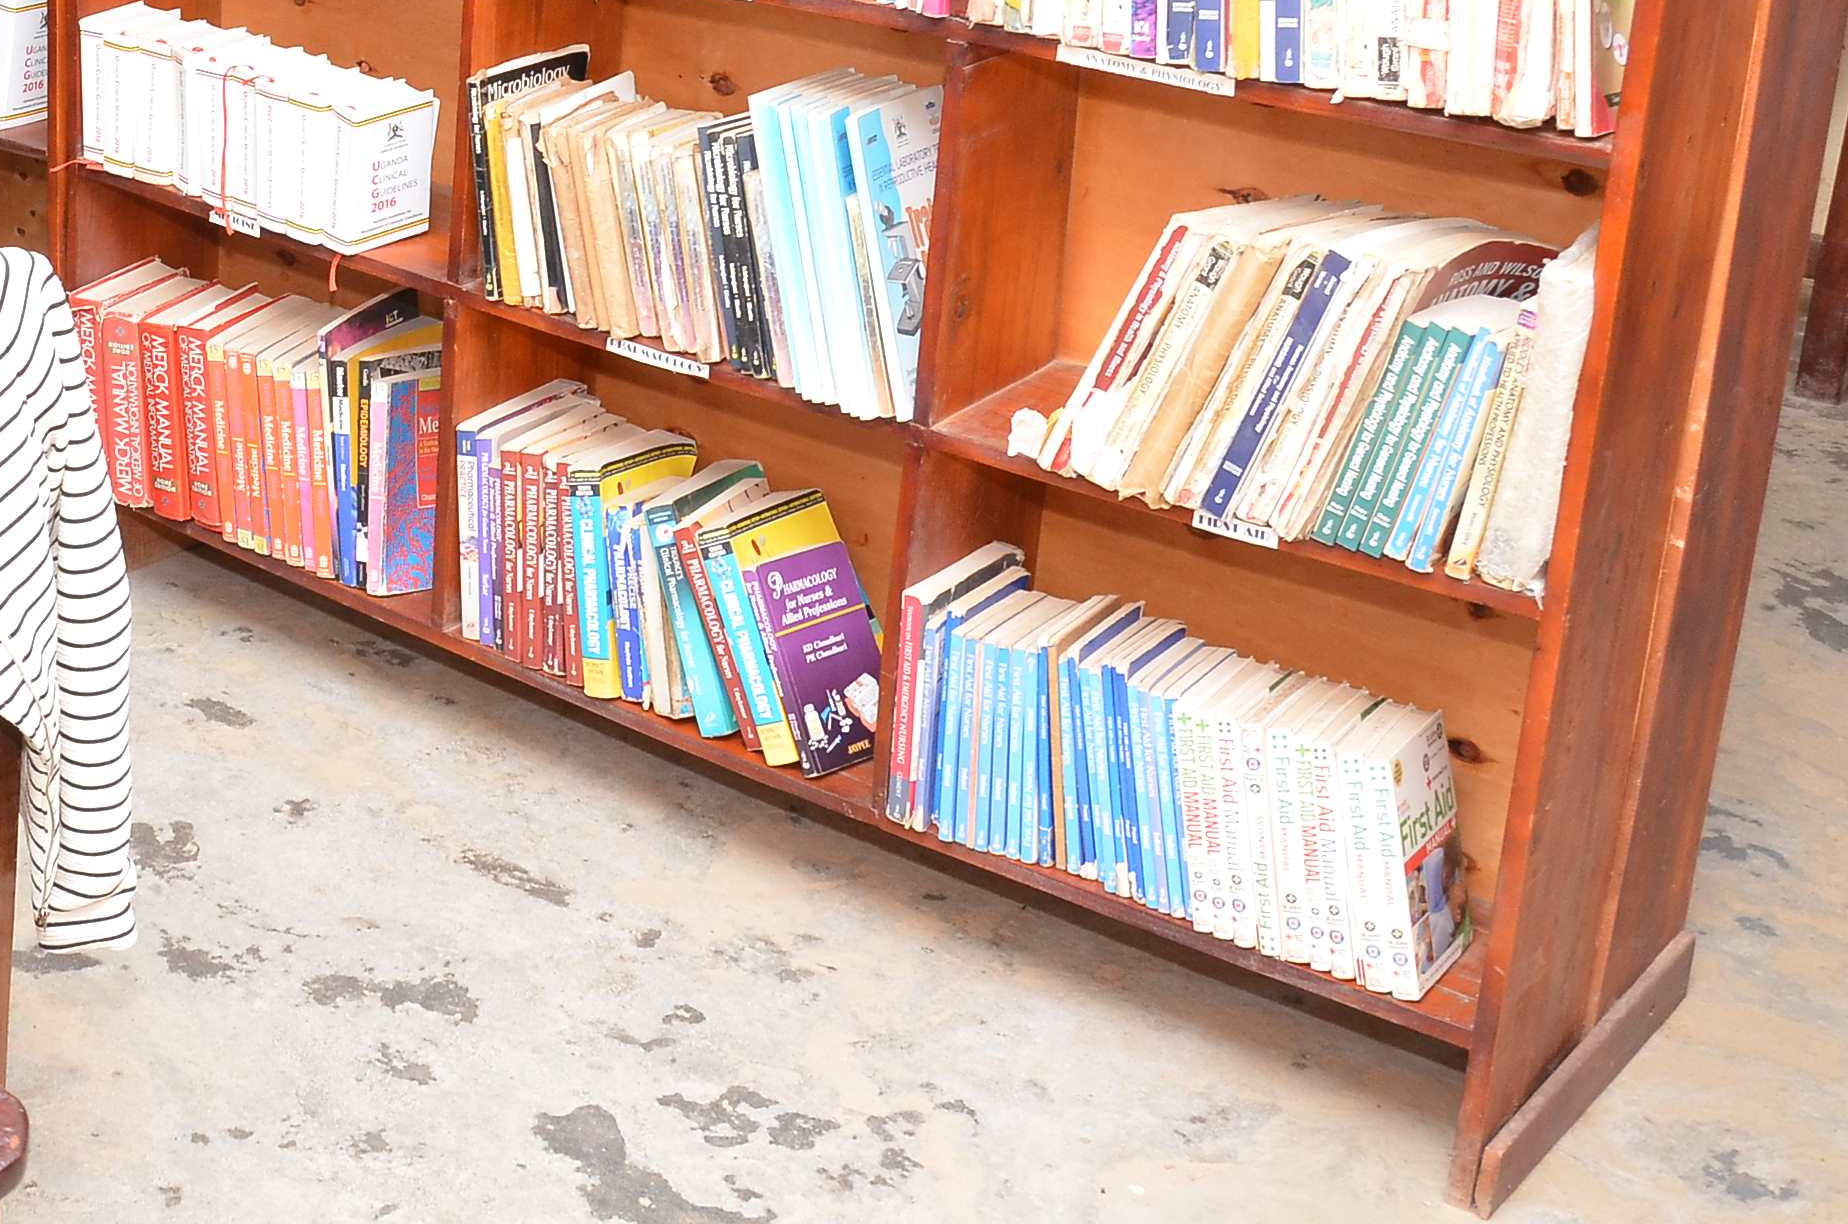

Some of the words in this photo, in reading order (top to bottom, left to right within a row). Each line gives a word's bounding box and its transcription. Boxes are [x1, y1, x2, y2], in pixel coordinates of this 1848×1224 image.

[487, 65, 571, 104] Microbiology
[1084, 53, 1136, 73] ANATOMY
[1151, 68, 1226, 93] PHYSIOLOGY
[372, 155, 409, 172] UGANDA
[371, 179, 419, 199] GUIDELINES
[371, 196, 397, 213] 2016
[725, 144, 739, 196] Microbiology
[733, 209, 744, 238] Nurses
[721, 207, 731, 235] Nurses
[142, 332, 152, 349] OF
[143, 350, 155, 396] MEDICAL
[152, 334, 169, 395] MERCK
[188, 336, 206, 398] MERCK
[111, 360, 130, 434] MANUAL
[125, 360, 140, 434] INFORMATION
[1409, 398, 1441, 443] Physiology
[147, 398, 161, 472] INFORMATION
[154, 398, 173, 473] MANUAL
[192, 400, 210, 476] MANUAL
[214, 400, 227, 450] Medicine
[263, 414, 276, 466] Medicine
[280, 420, 294, 472] Medicine
[358, 398, 370, 468] EPIDEMIOLOGY
[114, 437, 133, 495] MERCK
[130, 436, 143, 478] MEDICAL
[1396, 451, 1417, 483] General
[132, 477, 144, 497] OF
[467, 459, 477, 533] Pharmaceutical
[580, 518, 596, 567] CLINICAL
[686, 558, 726, 645] PHARMACOLOGY
[767, 568, 838, 600] PHARMACOLOGY
[797, 588, 825, 607] Nurses
[583, 567, 601, 656] PHARMACOLOGY
[781, 609, 804, 627] Allied
[803, 597, 848, 622] Professions
[736, 630, 773, 719] PHARMACOLOGY
[896, 723, 908, 765] NURSING
[1218, 738, 1234, 773] First
[1221, 776, 1239, 805] Aid
[1314, 765, 1330, 799] First
[1183, 792, 1204, 850] MANUAL
[1318, 804, 1336, 833] Aid
[1400, 800, 1432, 859] First
[1434, 776, 1456, 827] Aid
